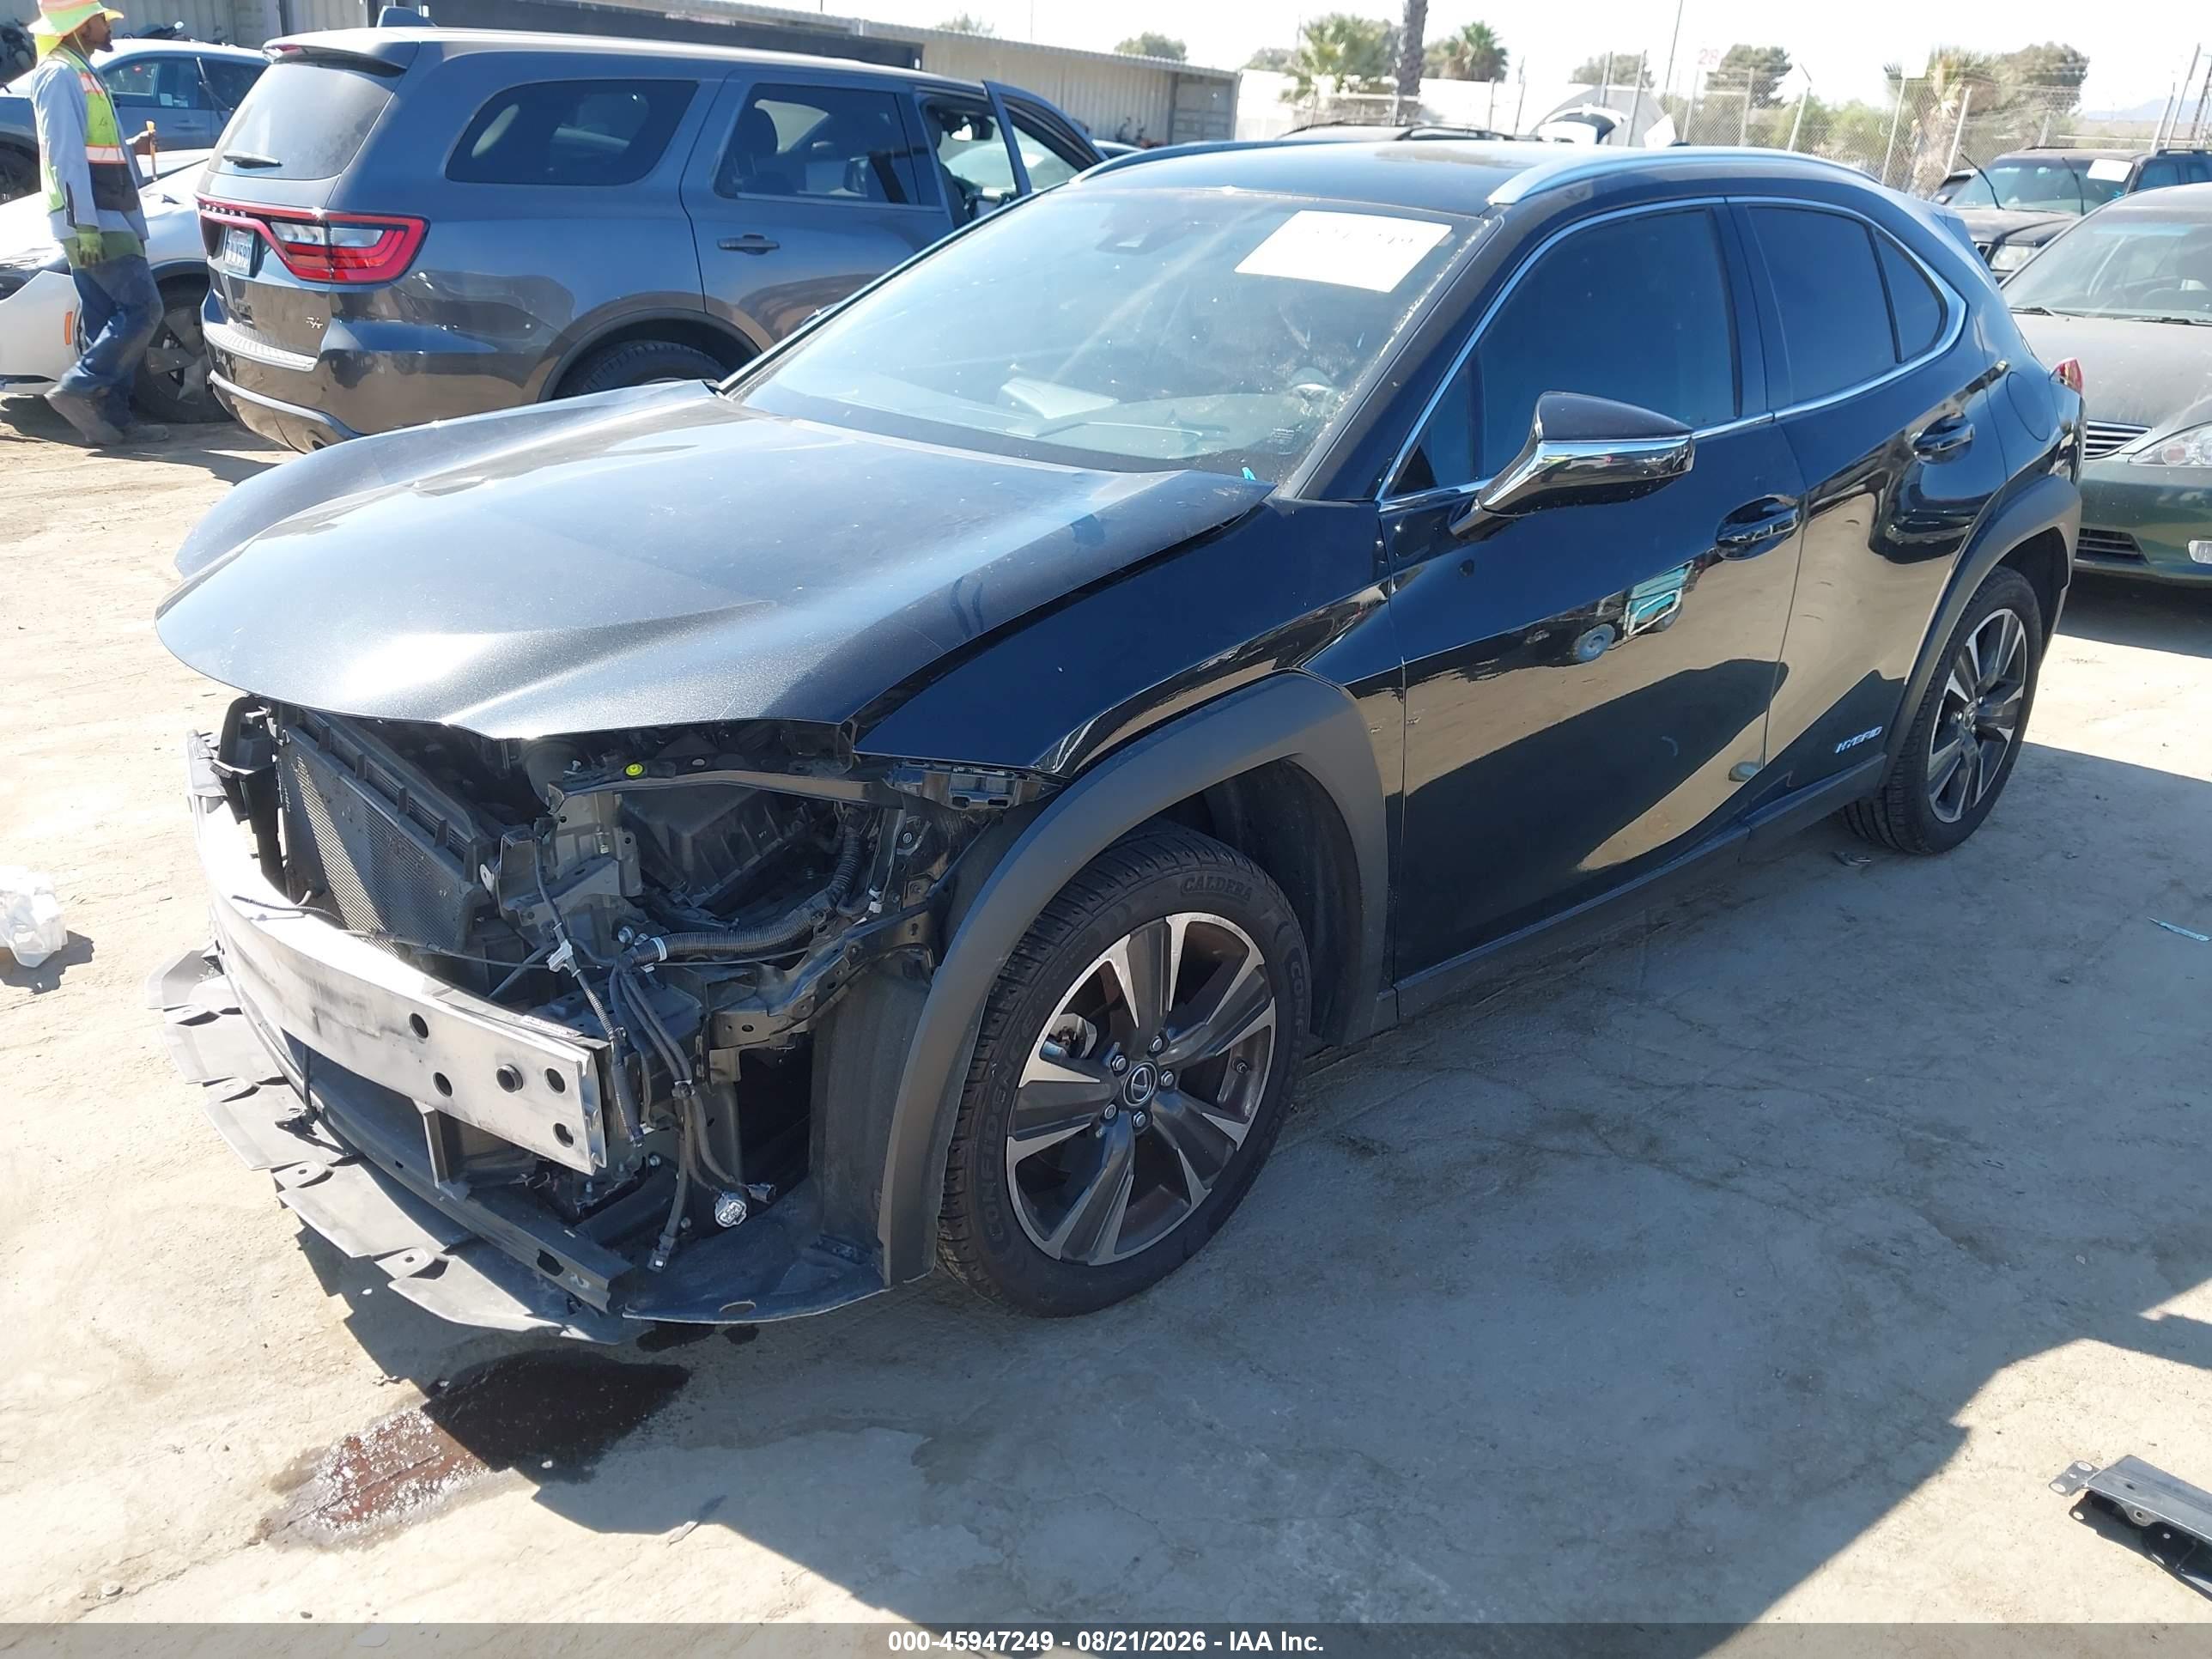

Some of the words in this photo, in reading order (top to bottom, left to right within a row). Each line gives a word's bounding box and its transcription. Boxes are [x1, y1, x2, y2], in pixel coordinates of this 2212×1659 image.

[1834, 726, 1883, 754] HYBRID
[1183, 874, 1254, 903] CALDERA
[980, 1011, 1038, 1241] CONFIDENCE
